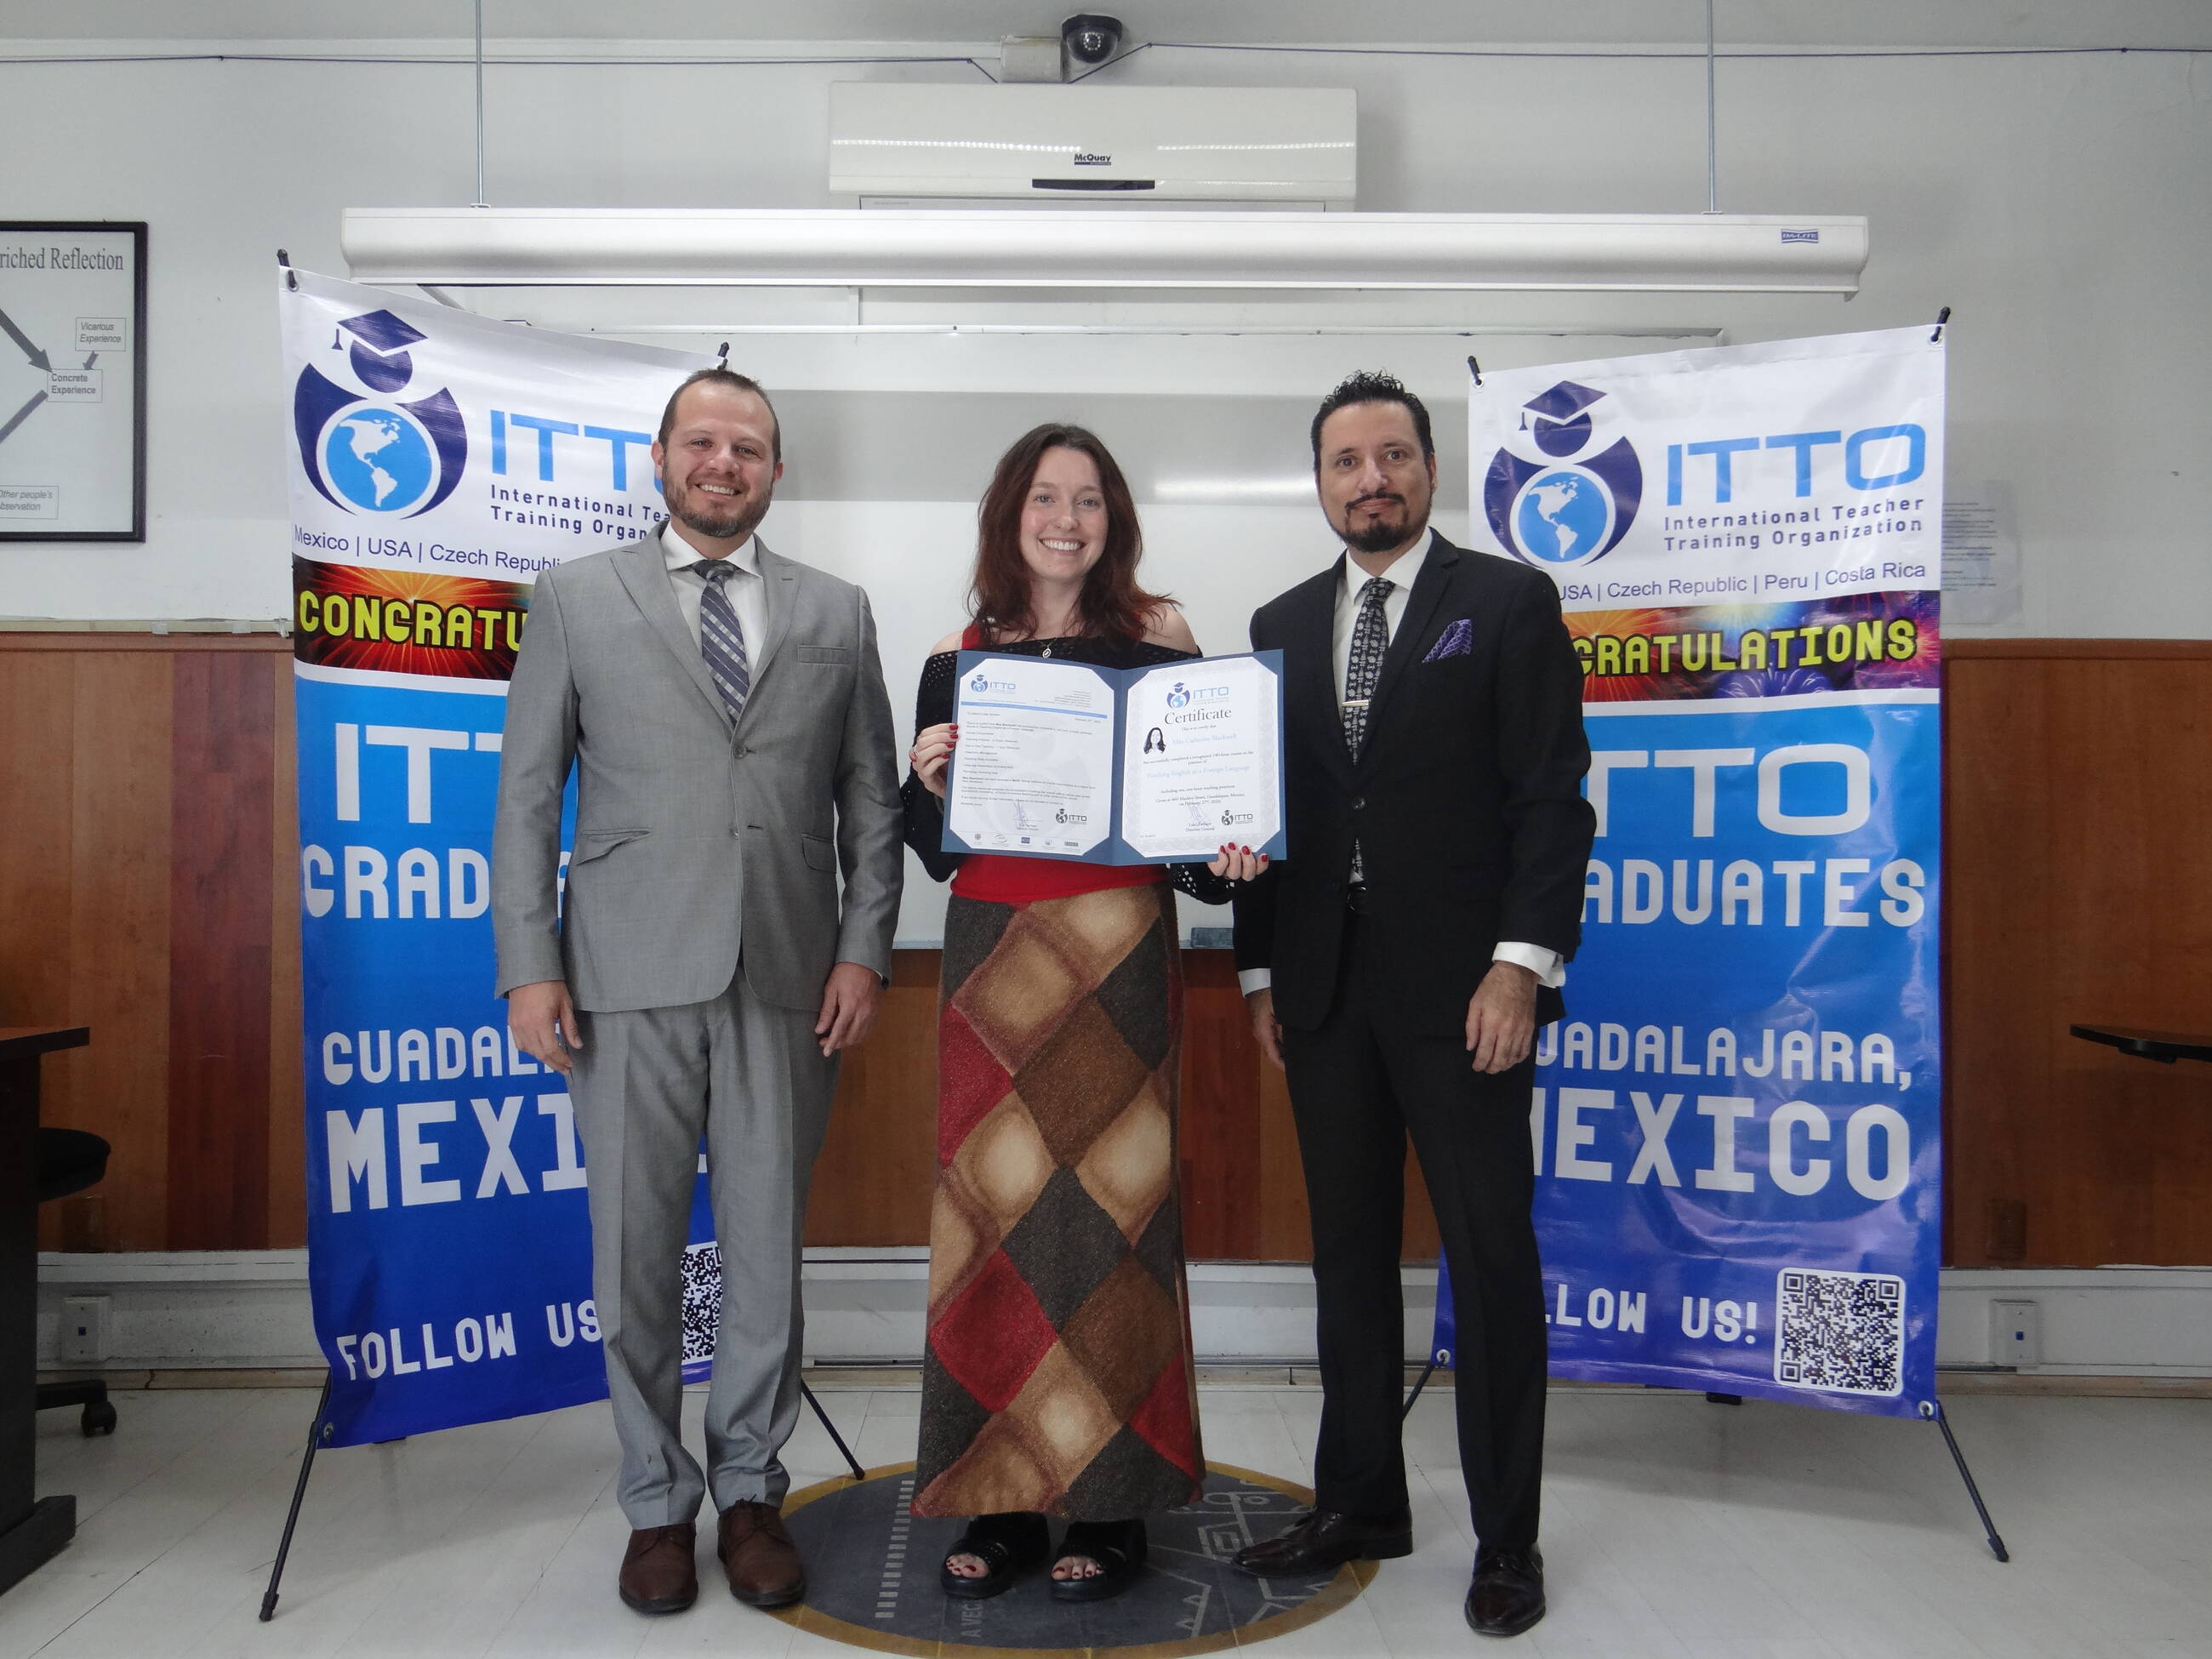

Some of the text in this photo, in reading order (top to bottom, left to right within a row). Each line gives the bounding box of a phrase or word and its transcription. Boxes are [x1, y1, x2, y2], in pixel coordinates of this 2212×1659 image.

[1074, 153, 1111, 162] McQuay
[0, 247, 124, 271] riched Reflection
[79, 334, 122, 345] Experience
[81, 322, 115, 331] Vicarious
[51, 373, 88, 382] Concrete
[51, 385, 96, 395] Experience
[490, 409, 664, 495] ITT
[1667, 424, 1926, 506] ITTO
[0, 502, 41, 510] bservation
[491, 484, 670, 523] International Tea
[491, 505, 647, 540] Training Organ
[1664, 498, 1925, 531] International Teacher
[294, 524, 561, 573] Mexico USA Czech Republ
[1664, 519, 1922, 550] Training Organization
[1607, 581, 1662, 598] Czech
[1668, 576, 1747, 596] Republic
[1764, 574, 1808, 590] Peru
[1825, 566, 1875, 585] Costa
[1883, 562, 1926, 579] Rica
[299, 590, 529, 650] CONGRATU
[1572, 619, 1918, 675] GRATULATIONS
[989, 681, 1017, 690] ITTO
[1193, 686, 1229, 699] ITTO
[1164, 708, 1232, 724] Certificate
[335, 723, 503, 824] IT
[1587, 743, 1871, 838] TTO
[302, 844, 490, 920] GRAD
[1580, 858, 1925, 927] ADUATES
[322, 1025, 544, 1086] GUADAL
[1536, 1021, 1912, 1092] UADALAJARA,
[327, 1093, 588, 1214] MEXI
[1545, 1283, 1758, 1344] LOW US!
[336, 1299, 603, 1381] FOLLOW US
